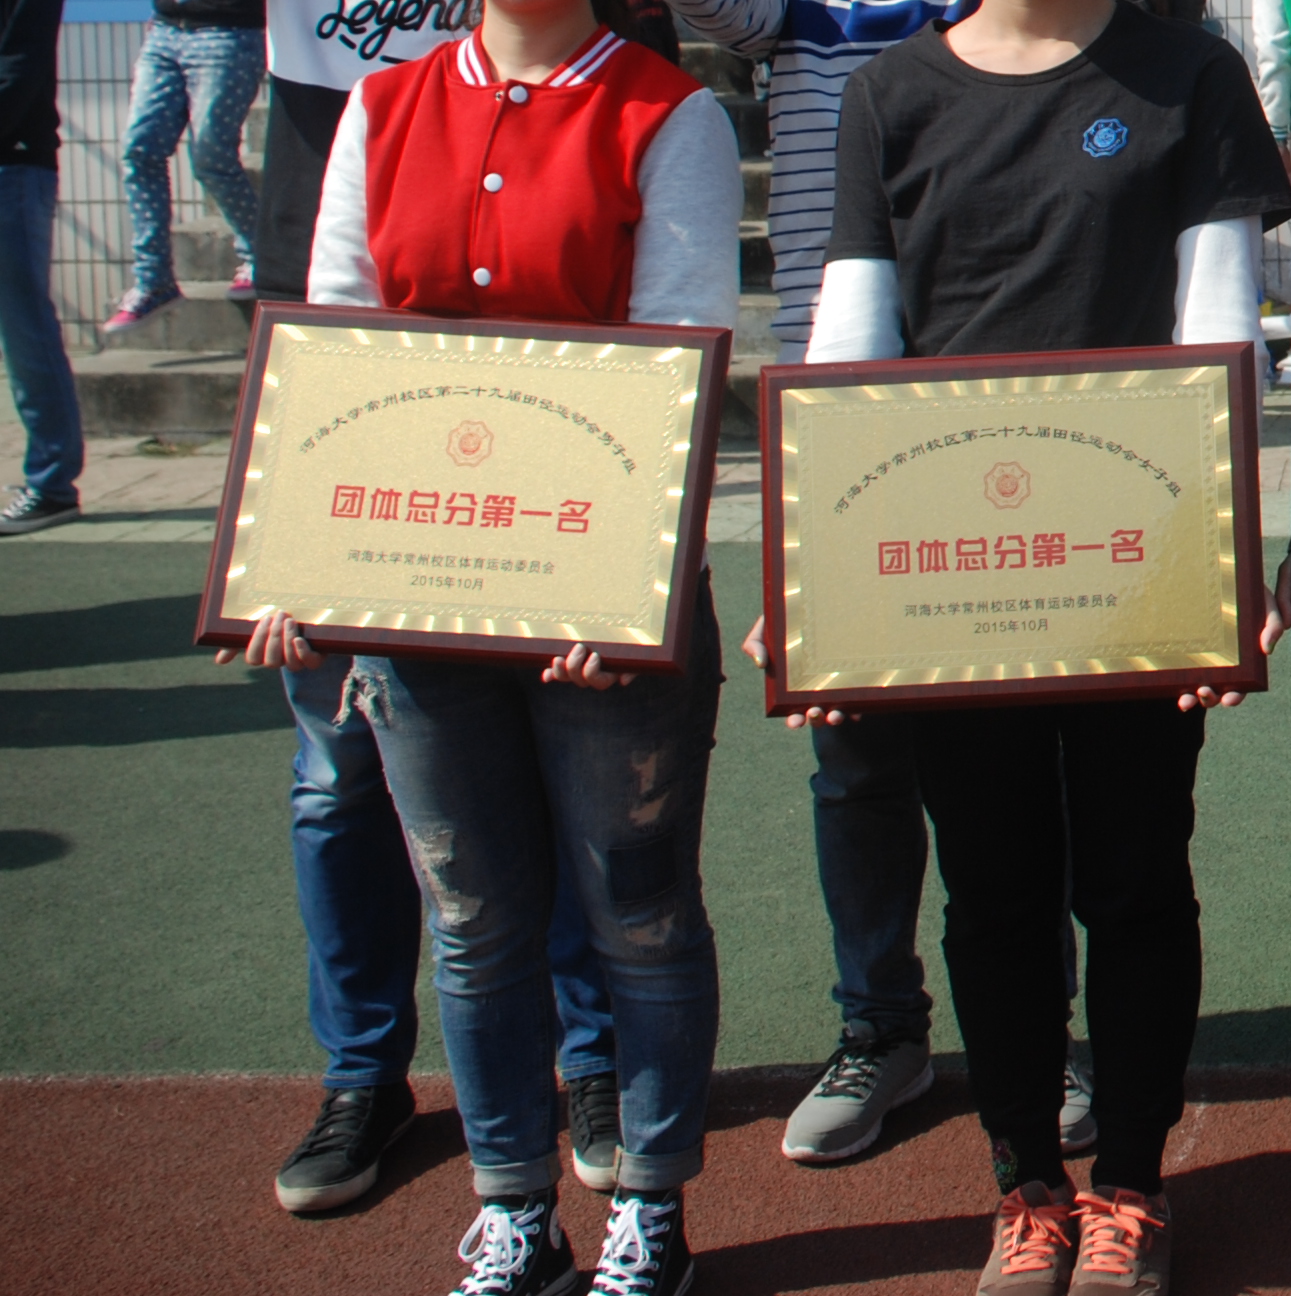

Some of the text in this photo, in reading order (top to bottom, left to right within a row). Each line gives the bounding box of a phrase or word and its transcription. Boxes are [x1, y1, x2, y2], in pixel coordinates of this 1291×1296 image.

[331, 484, 593, 533] 团体总分第一名
[347, 549, 556, 575] 河海大学常州校区体育运动委员会
[877, 529, 1145, 575] 团体总分第一名
[410, 574, 484, 591] 2015年10月
[904, 593, 1118, 618] 河海大学常州校区体育运动委员会
[974, 618, 1049, 634] 2015年10月
